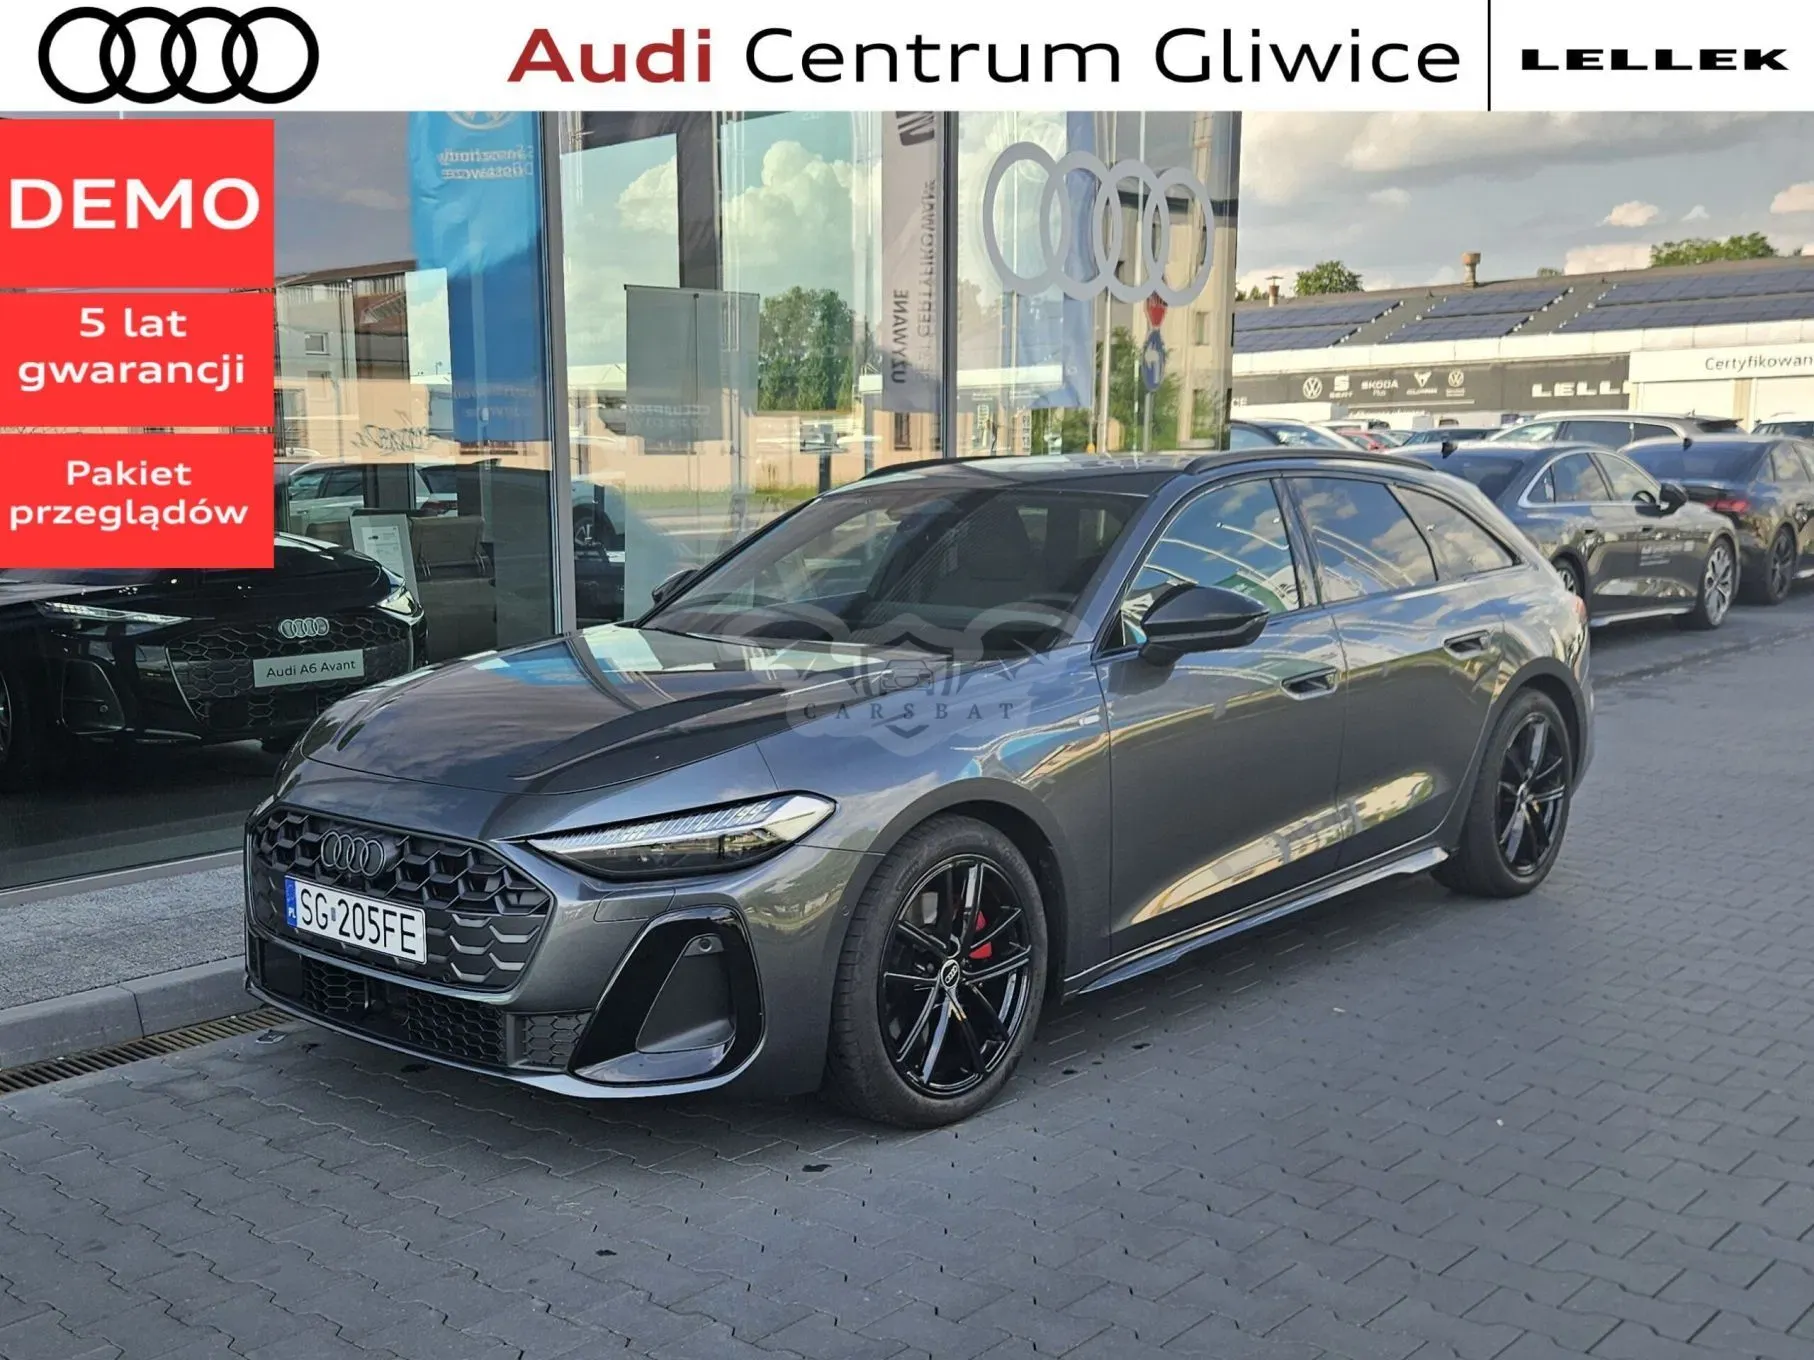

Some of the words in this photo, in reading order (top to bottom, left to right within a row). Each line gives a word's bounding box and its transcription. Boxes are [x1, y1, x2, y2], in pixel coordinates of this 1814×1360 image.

[1704, 354, 1813, 372] Certyfikowan
[266, 666, 297, 678] Audi
[300, 663, 317, 674] A6
[320, 660, 356, 673] Avant
[300, 888, 329, 930] SG
[337, 898, 416, 955] 205FE
